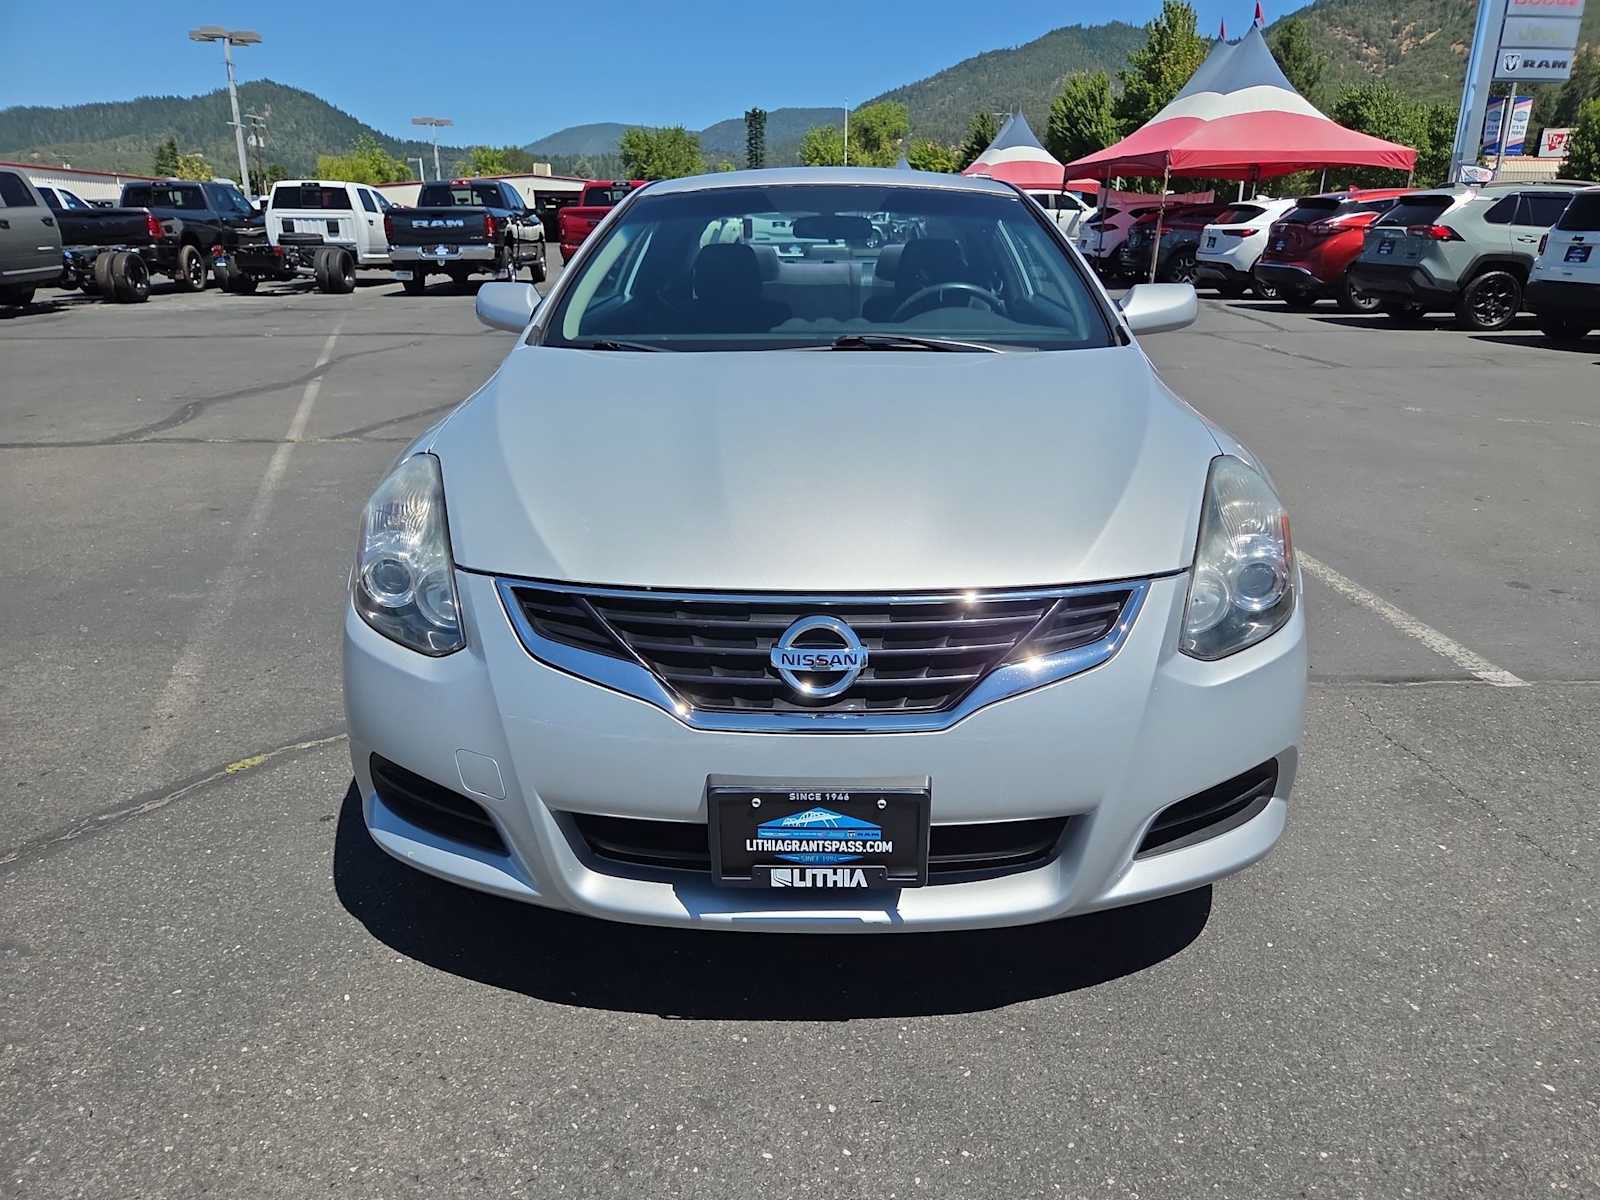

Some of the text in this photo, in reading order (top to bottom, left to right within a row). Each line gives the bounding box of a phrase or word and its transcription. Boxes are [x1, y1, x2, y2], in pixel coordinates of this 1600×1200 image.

[1523, 60, 1568, 69] RAM
[412, 220, 464, 228] RAM
[781, 653, 857, 666] NISSAN
[789, 793, 850, 801] SINCE 1946
[746, 839, 893, 853] LITHIAGRANTSPASS.COM
[793, 869, 868, 887] LITHIA
